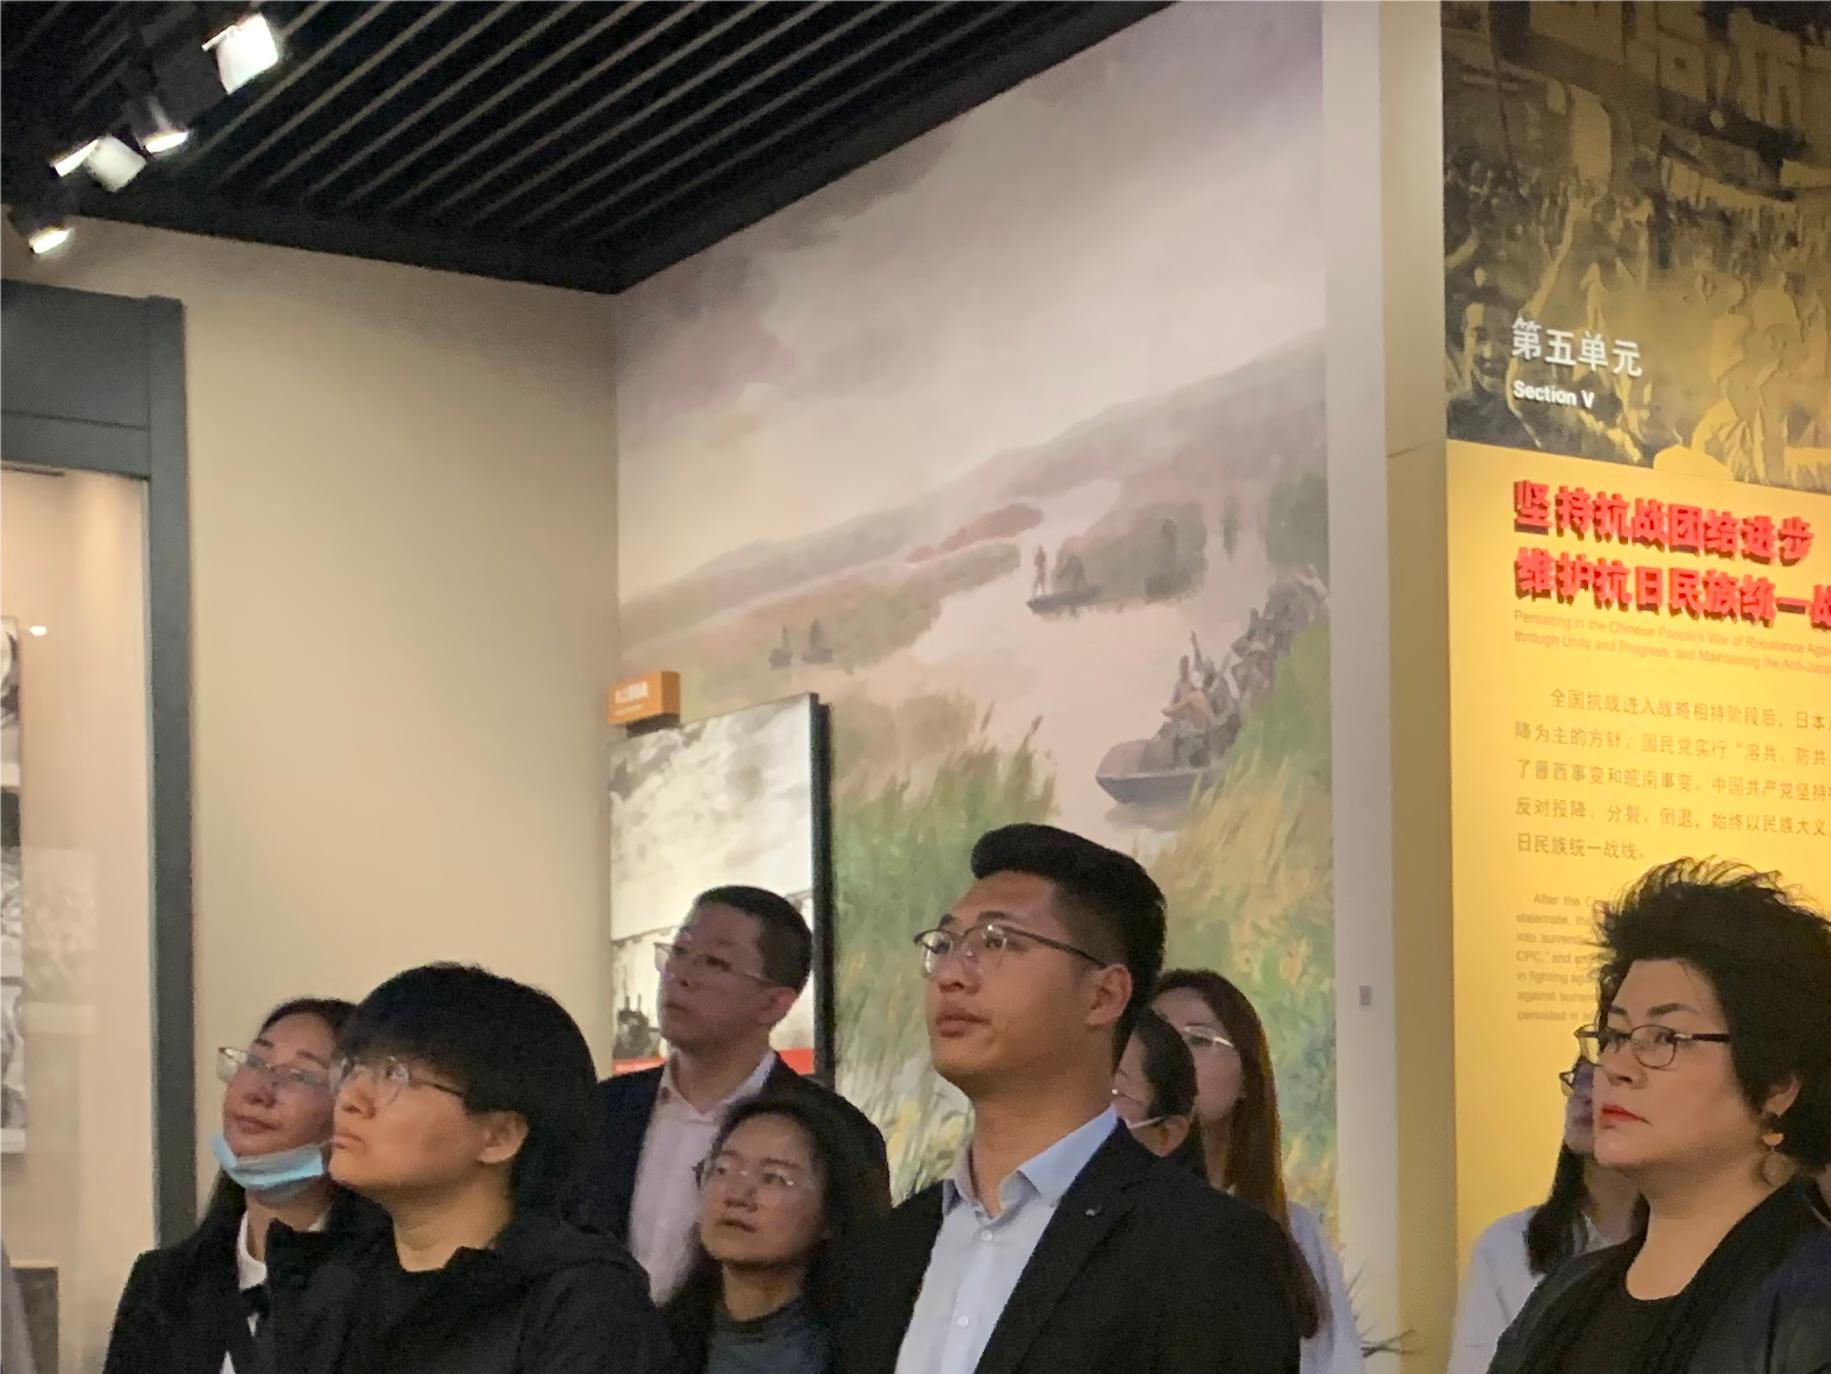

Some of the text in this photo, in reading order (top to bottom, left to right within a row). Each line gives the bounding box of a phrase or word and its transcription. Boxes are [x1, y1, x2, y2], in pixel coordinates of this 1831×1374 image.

[1511, 316, 1643, 377] 第五单元
[1512, 380, 1595, 409] Section V
[1513, 480, 1814, 567] 坚持抗战团结进步
[1514, 630, 1559, 648] through
[1595, 639, 1616, 651] and
[1676, 648, 1696, 660] and
[1609, 621, 1655, 638] Chinese
[1708, 632, 1728, 645] War
